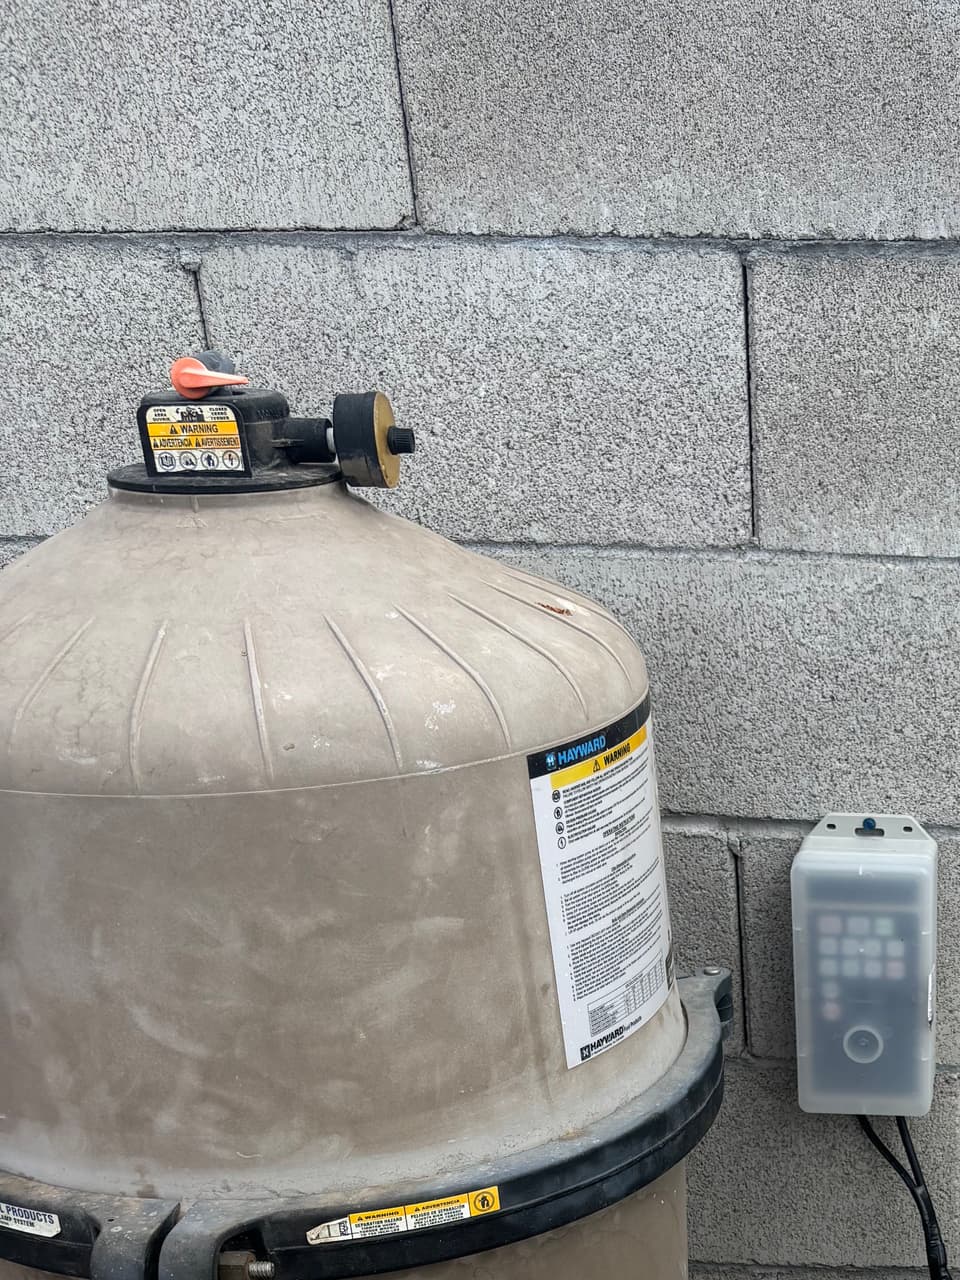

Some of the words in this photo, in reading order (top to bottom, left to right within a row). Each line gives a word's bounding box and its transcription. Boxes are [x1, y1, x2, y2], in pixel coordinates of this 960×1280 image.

[180, 424, 219, 434] WARNING
[160, 438, 193, 448] ADVERTENCIA
[202, 437, 240, 448] AVERTISSEMENT
[557, 735, 606, 765] HAYWARD
[603, 743, 631, 766] WARNING
[590, 1026, 624, 1052] HAYWARD
[421, 1199, 460, 1211] ADVERTENCIA
[6, 1205, 54, 1224] PRODUCTS
[364, 1211, 400, 1220] WARNING
